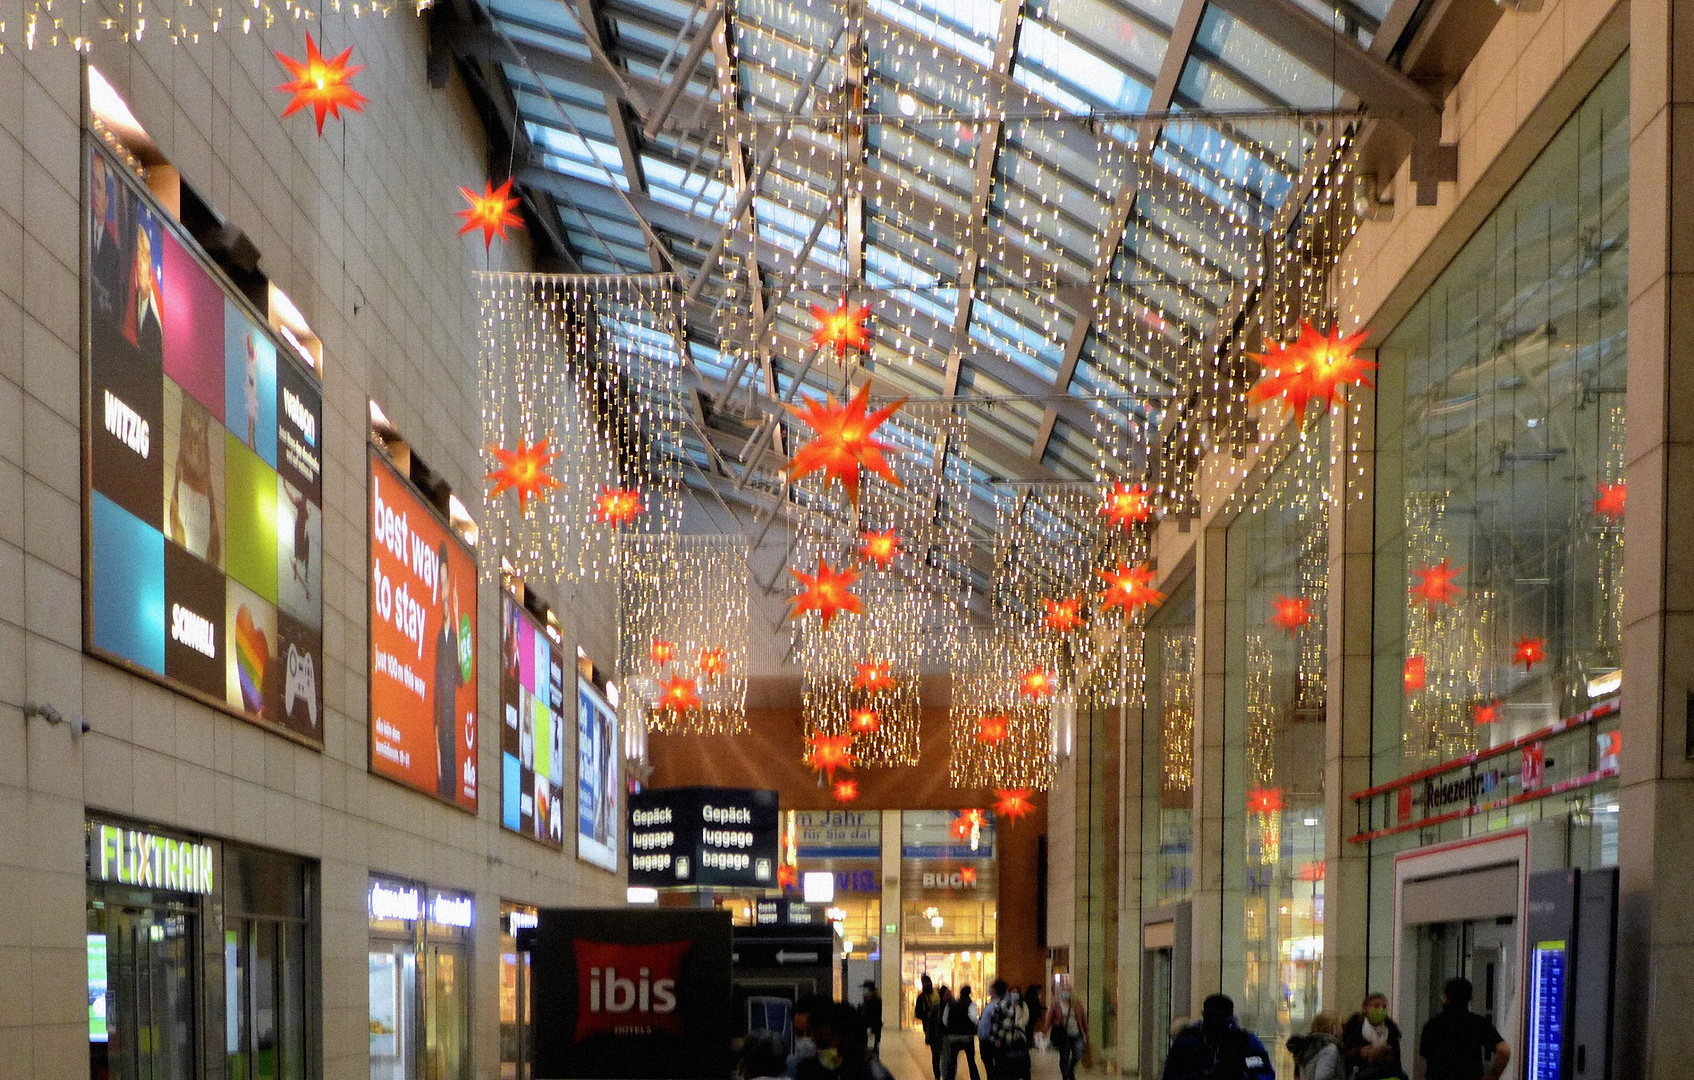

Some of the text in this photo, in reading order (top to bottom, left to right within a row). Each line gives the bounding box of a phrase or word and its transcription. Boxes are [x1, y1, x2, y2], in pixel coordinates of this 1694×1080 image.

[104, 388, 150, 460] WITZIG
[374, 475, 440, 605] best way
[373, 558, 426, 660] to stay
[1427, 768, 1499, 809] Reisezentr
[632, 806, 673, 828] Gepäck
[702, 804, 751, 825] Gepäck
[820, 810, 865, 827] Jahr
[632, 830, 675, 850] luggage
[702, 827, 754, 849] luggage
[803, 827, 871, 840] für Sie da!
[632, 853, 672, 872] bagage
[702, 850, 750, 871] bagage
[589, 966, 677, 1014] ibis
[614, 1024, 652, 1036] HOTELS
